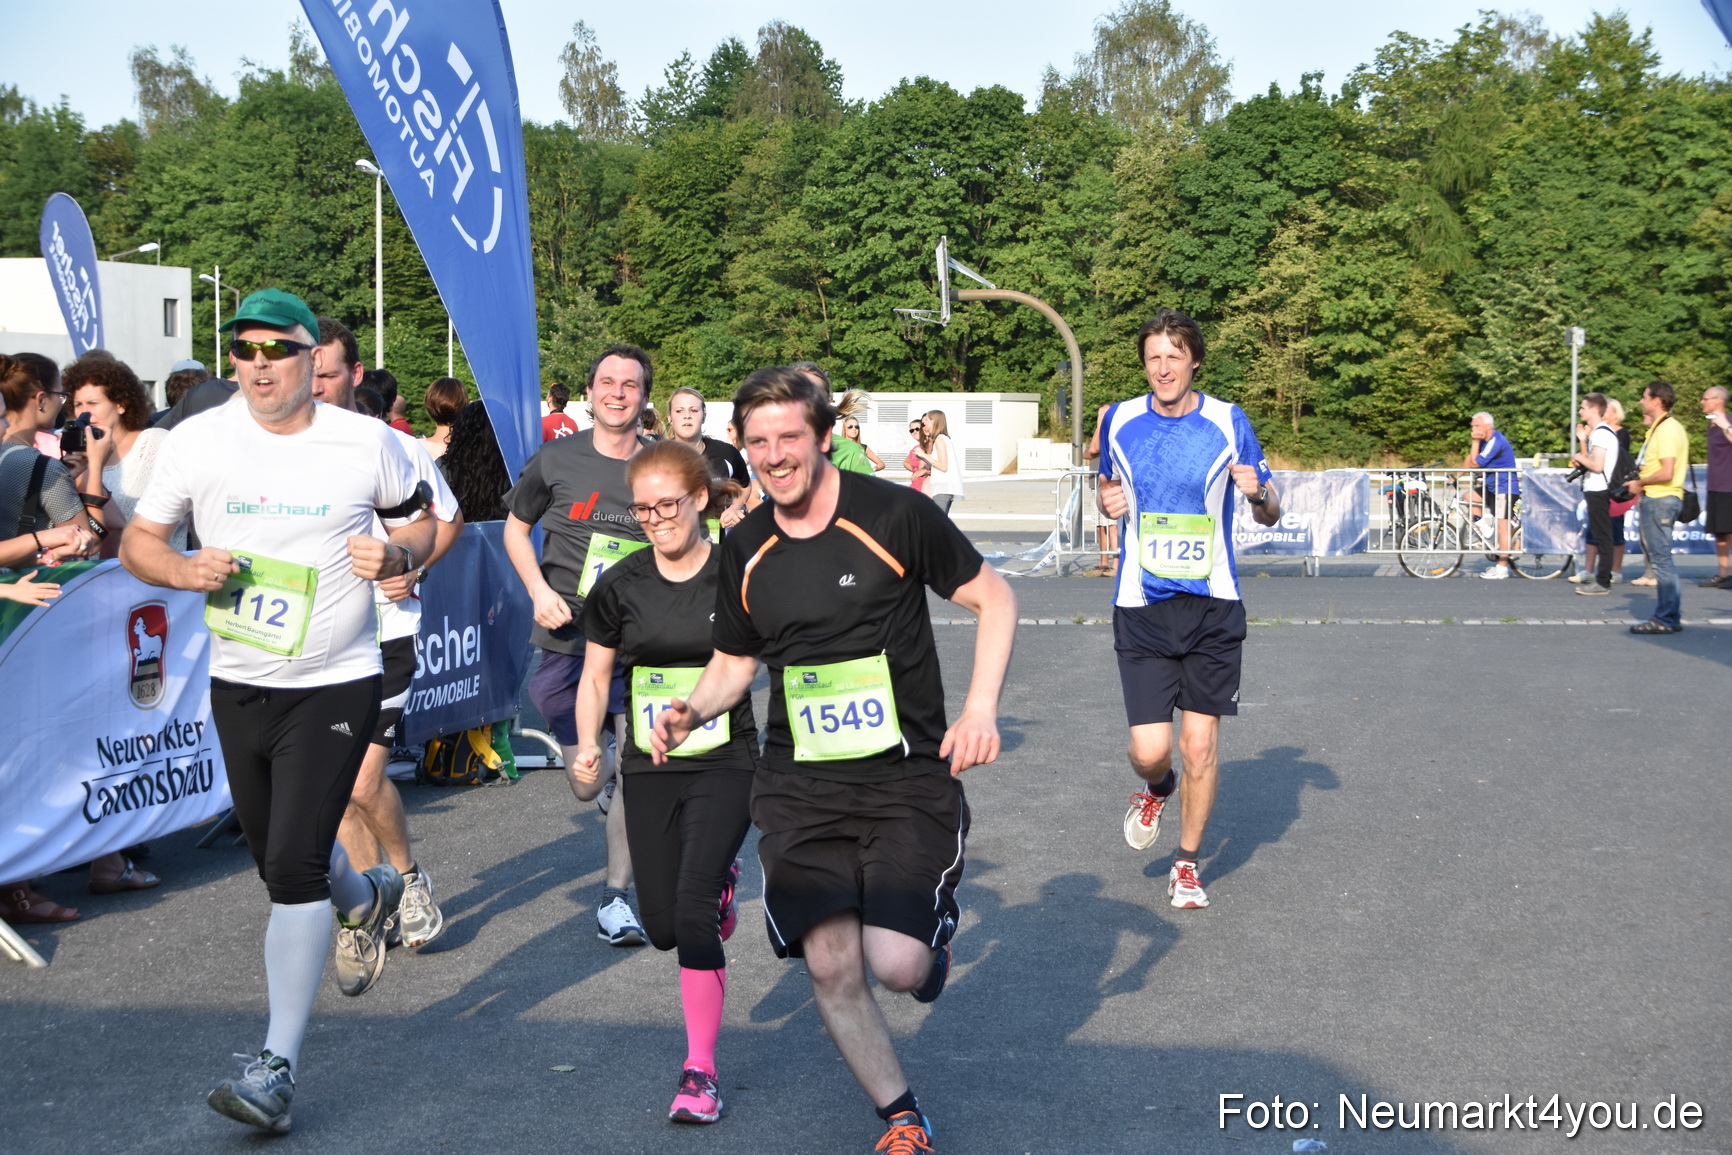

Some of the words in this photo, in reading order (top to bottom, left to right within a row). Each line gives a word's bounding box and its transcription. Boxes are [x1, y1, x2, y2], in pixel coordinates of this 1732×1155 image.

[227, 502, 331, 516] Gleichauf
[1148, 539, 1205, 561] 1125
[230, 587, 289, 628] 112
[225, 619, 247, 631] Herbert
[137, 682, 156, 699] 1628
[799, 698, 884, 734] 1549
